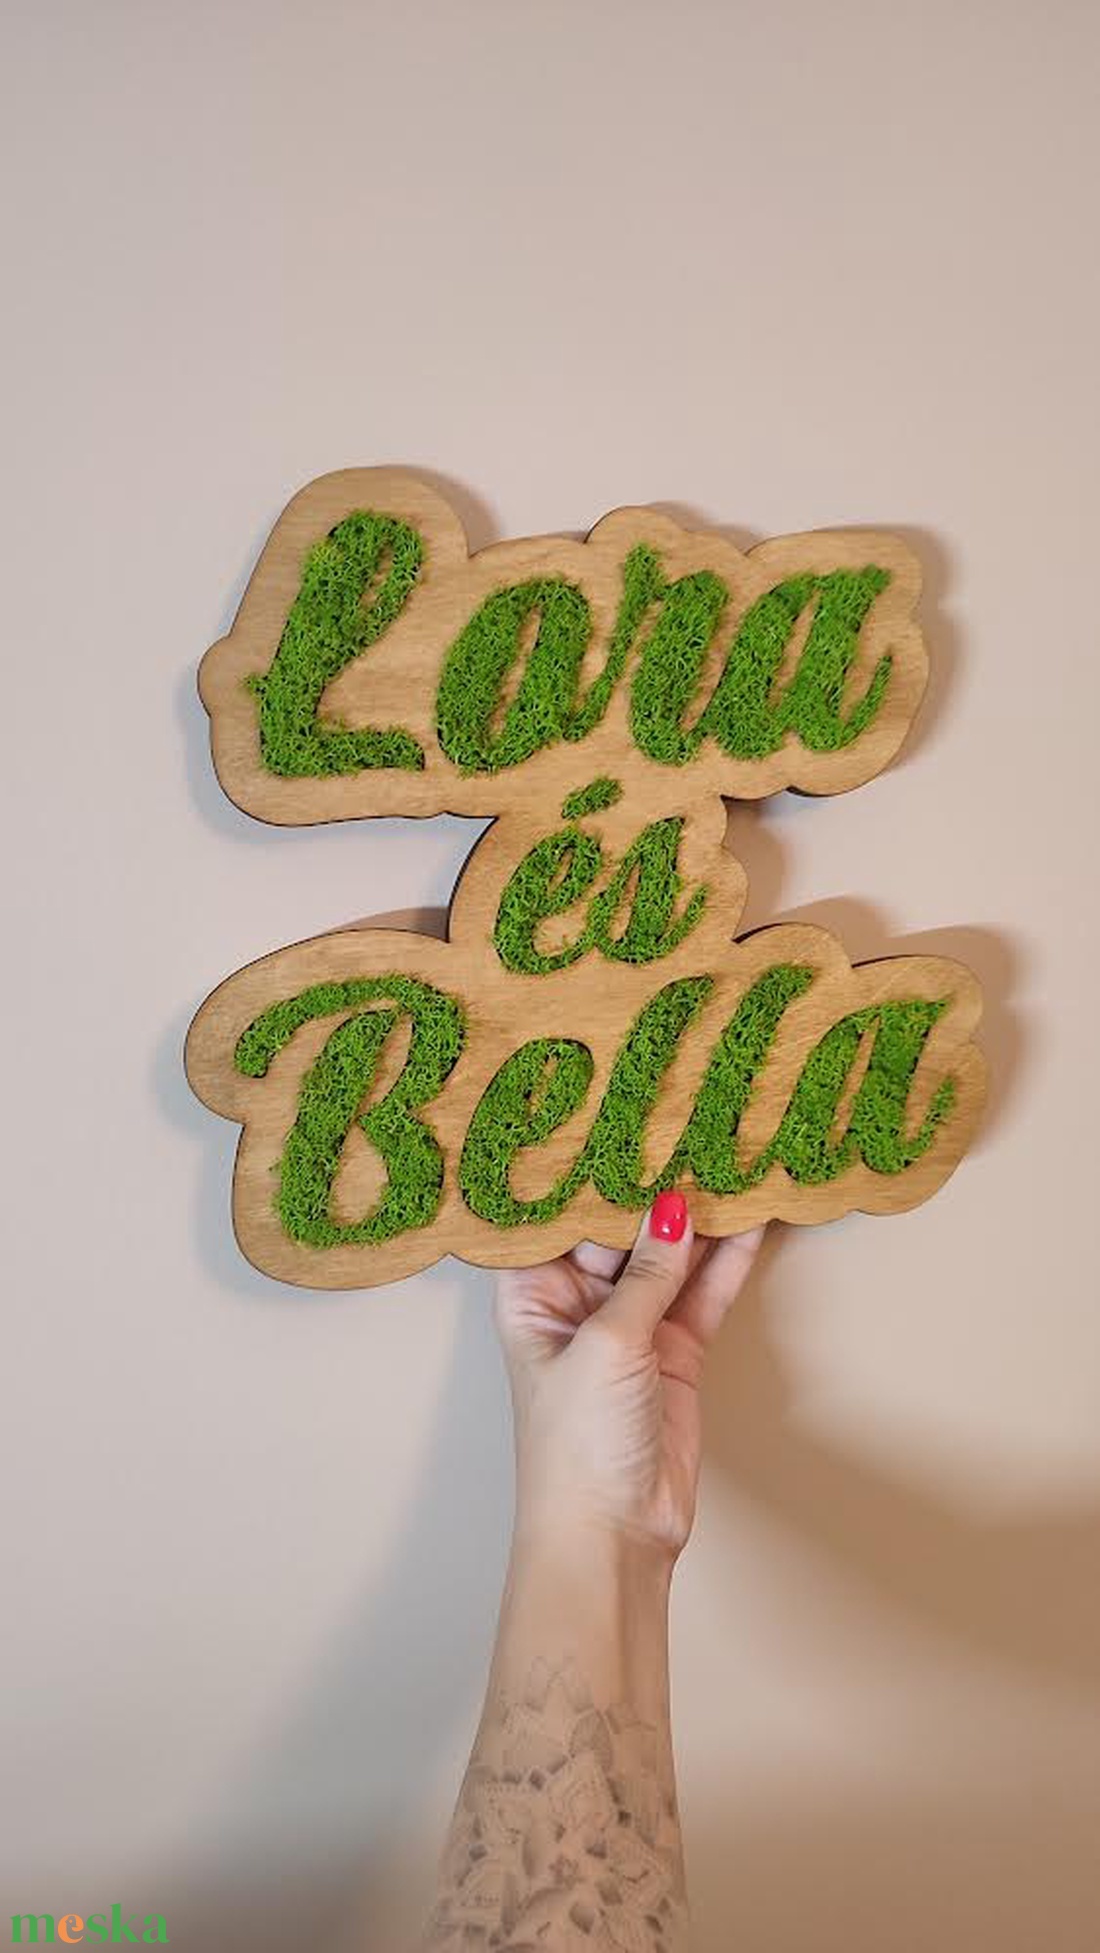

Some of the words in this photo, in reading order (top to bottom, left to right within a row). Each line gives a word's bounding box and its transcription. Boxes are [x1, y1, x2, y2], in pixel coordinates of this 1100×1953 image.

[249, 510, 892, 776] Lora
[493, 777, 708, 974] és
[235, 963, 956, 1248] Bella
